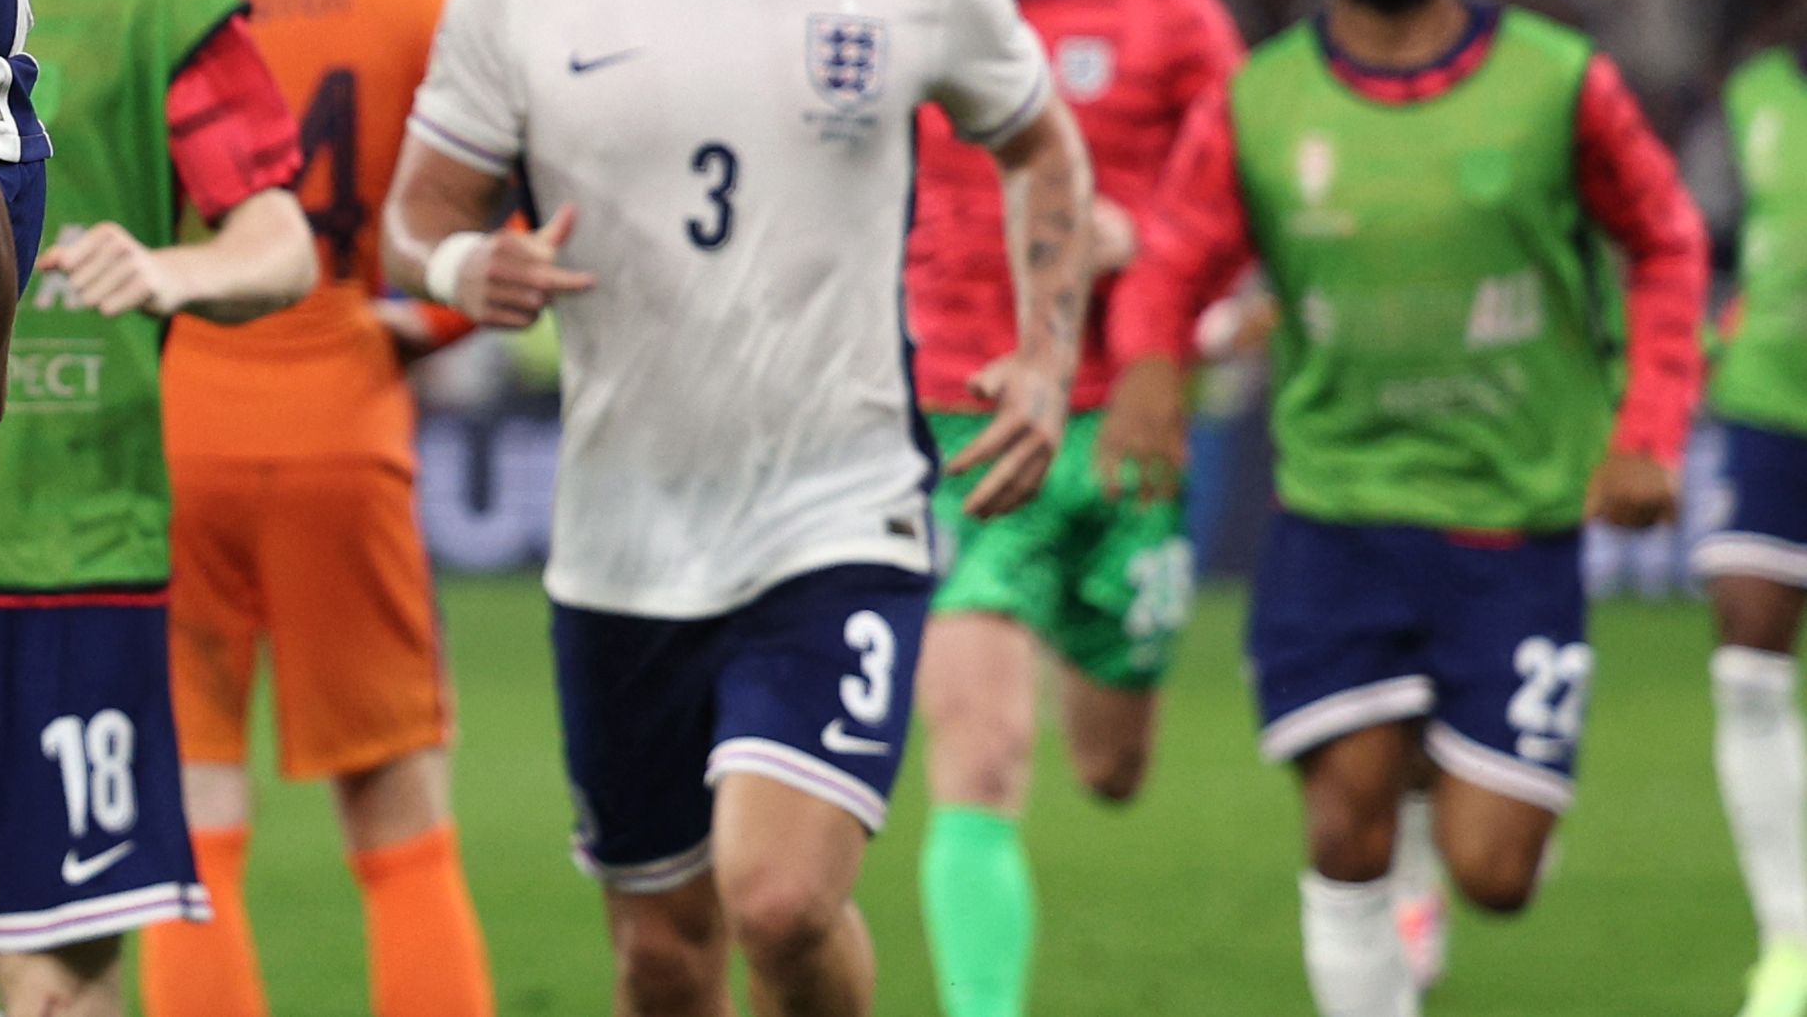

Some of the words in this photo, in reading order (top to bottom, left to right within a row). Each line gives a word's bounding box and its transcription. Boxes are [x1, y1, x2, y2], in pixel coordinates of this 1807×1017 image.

[685, 142, 739, 251] 3
[838, 608, 896, 728] 3
[40, 707, 138, 838] 18
